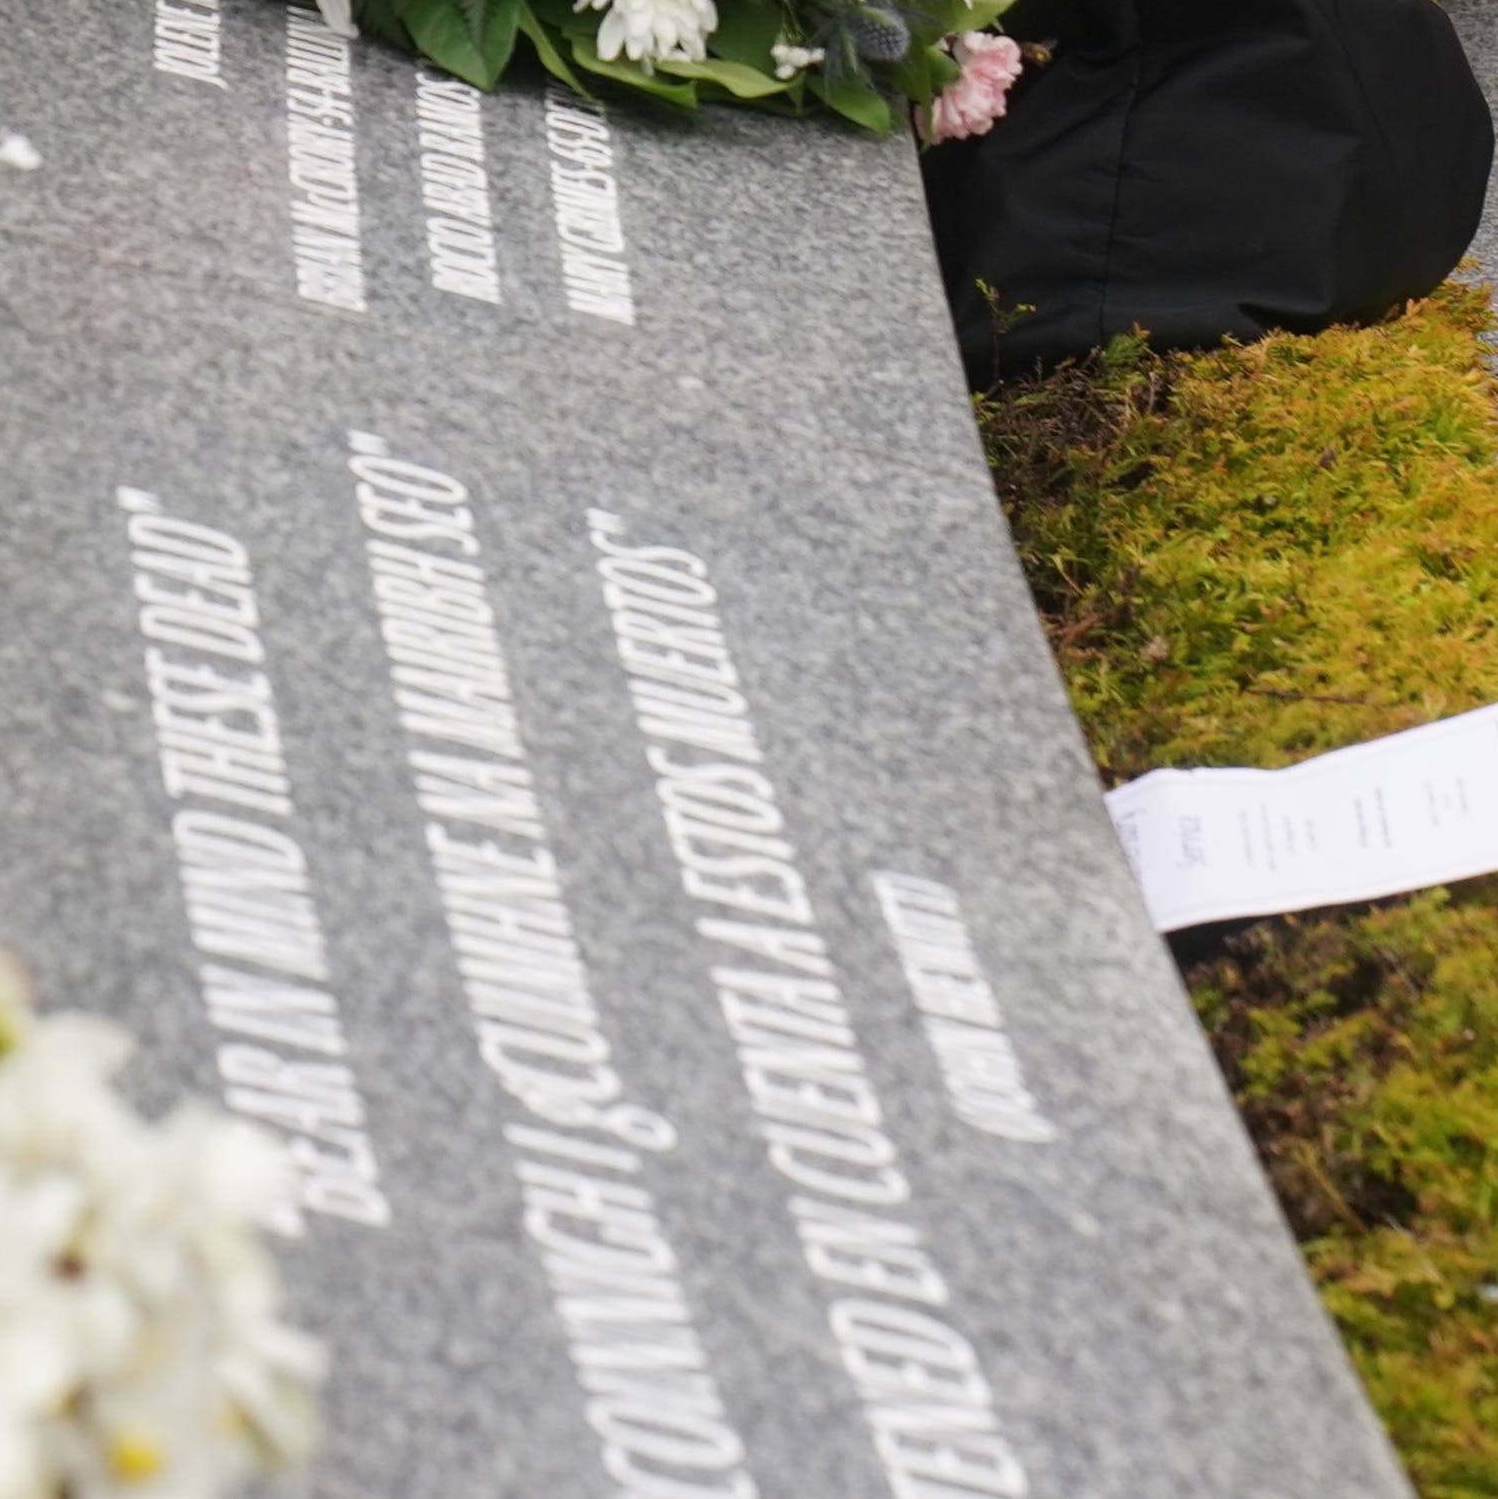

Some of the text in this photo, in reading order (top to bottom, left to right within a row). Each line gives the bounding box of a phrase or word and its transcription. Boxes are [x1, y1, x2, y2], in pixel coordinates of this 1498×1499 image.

[153, 0, 229, 89] JOLENE
[418, 151, 491, 226] ABAD
[292, 223, 367, 312] BRIAN
[559, 242, 636, 326] MARY
[363, 542, 526, 759] MAIRIBH
[143, 646, 295, 816] THESE
[407, 743, 548, 839] NA
[644, 744, 816, 926] ESTOS
[170, 809, 328, 982] MIND
[695, 917, 834, 974] A
[197, 963, 348, 1056] IN
[708, 964, 912, 1205] CUENTA
[502, 1123, 641, 1174] I
[786, 1196, 950, 1308] EN
